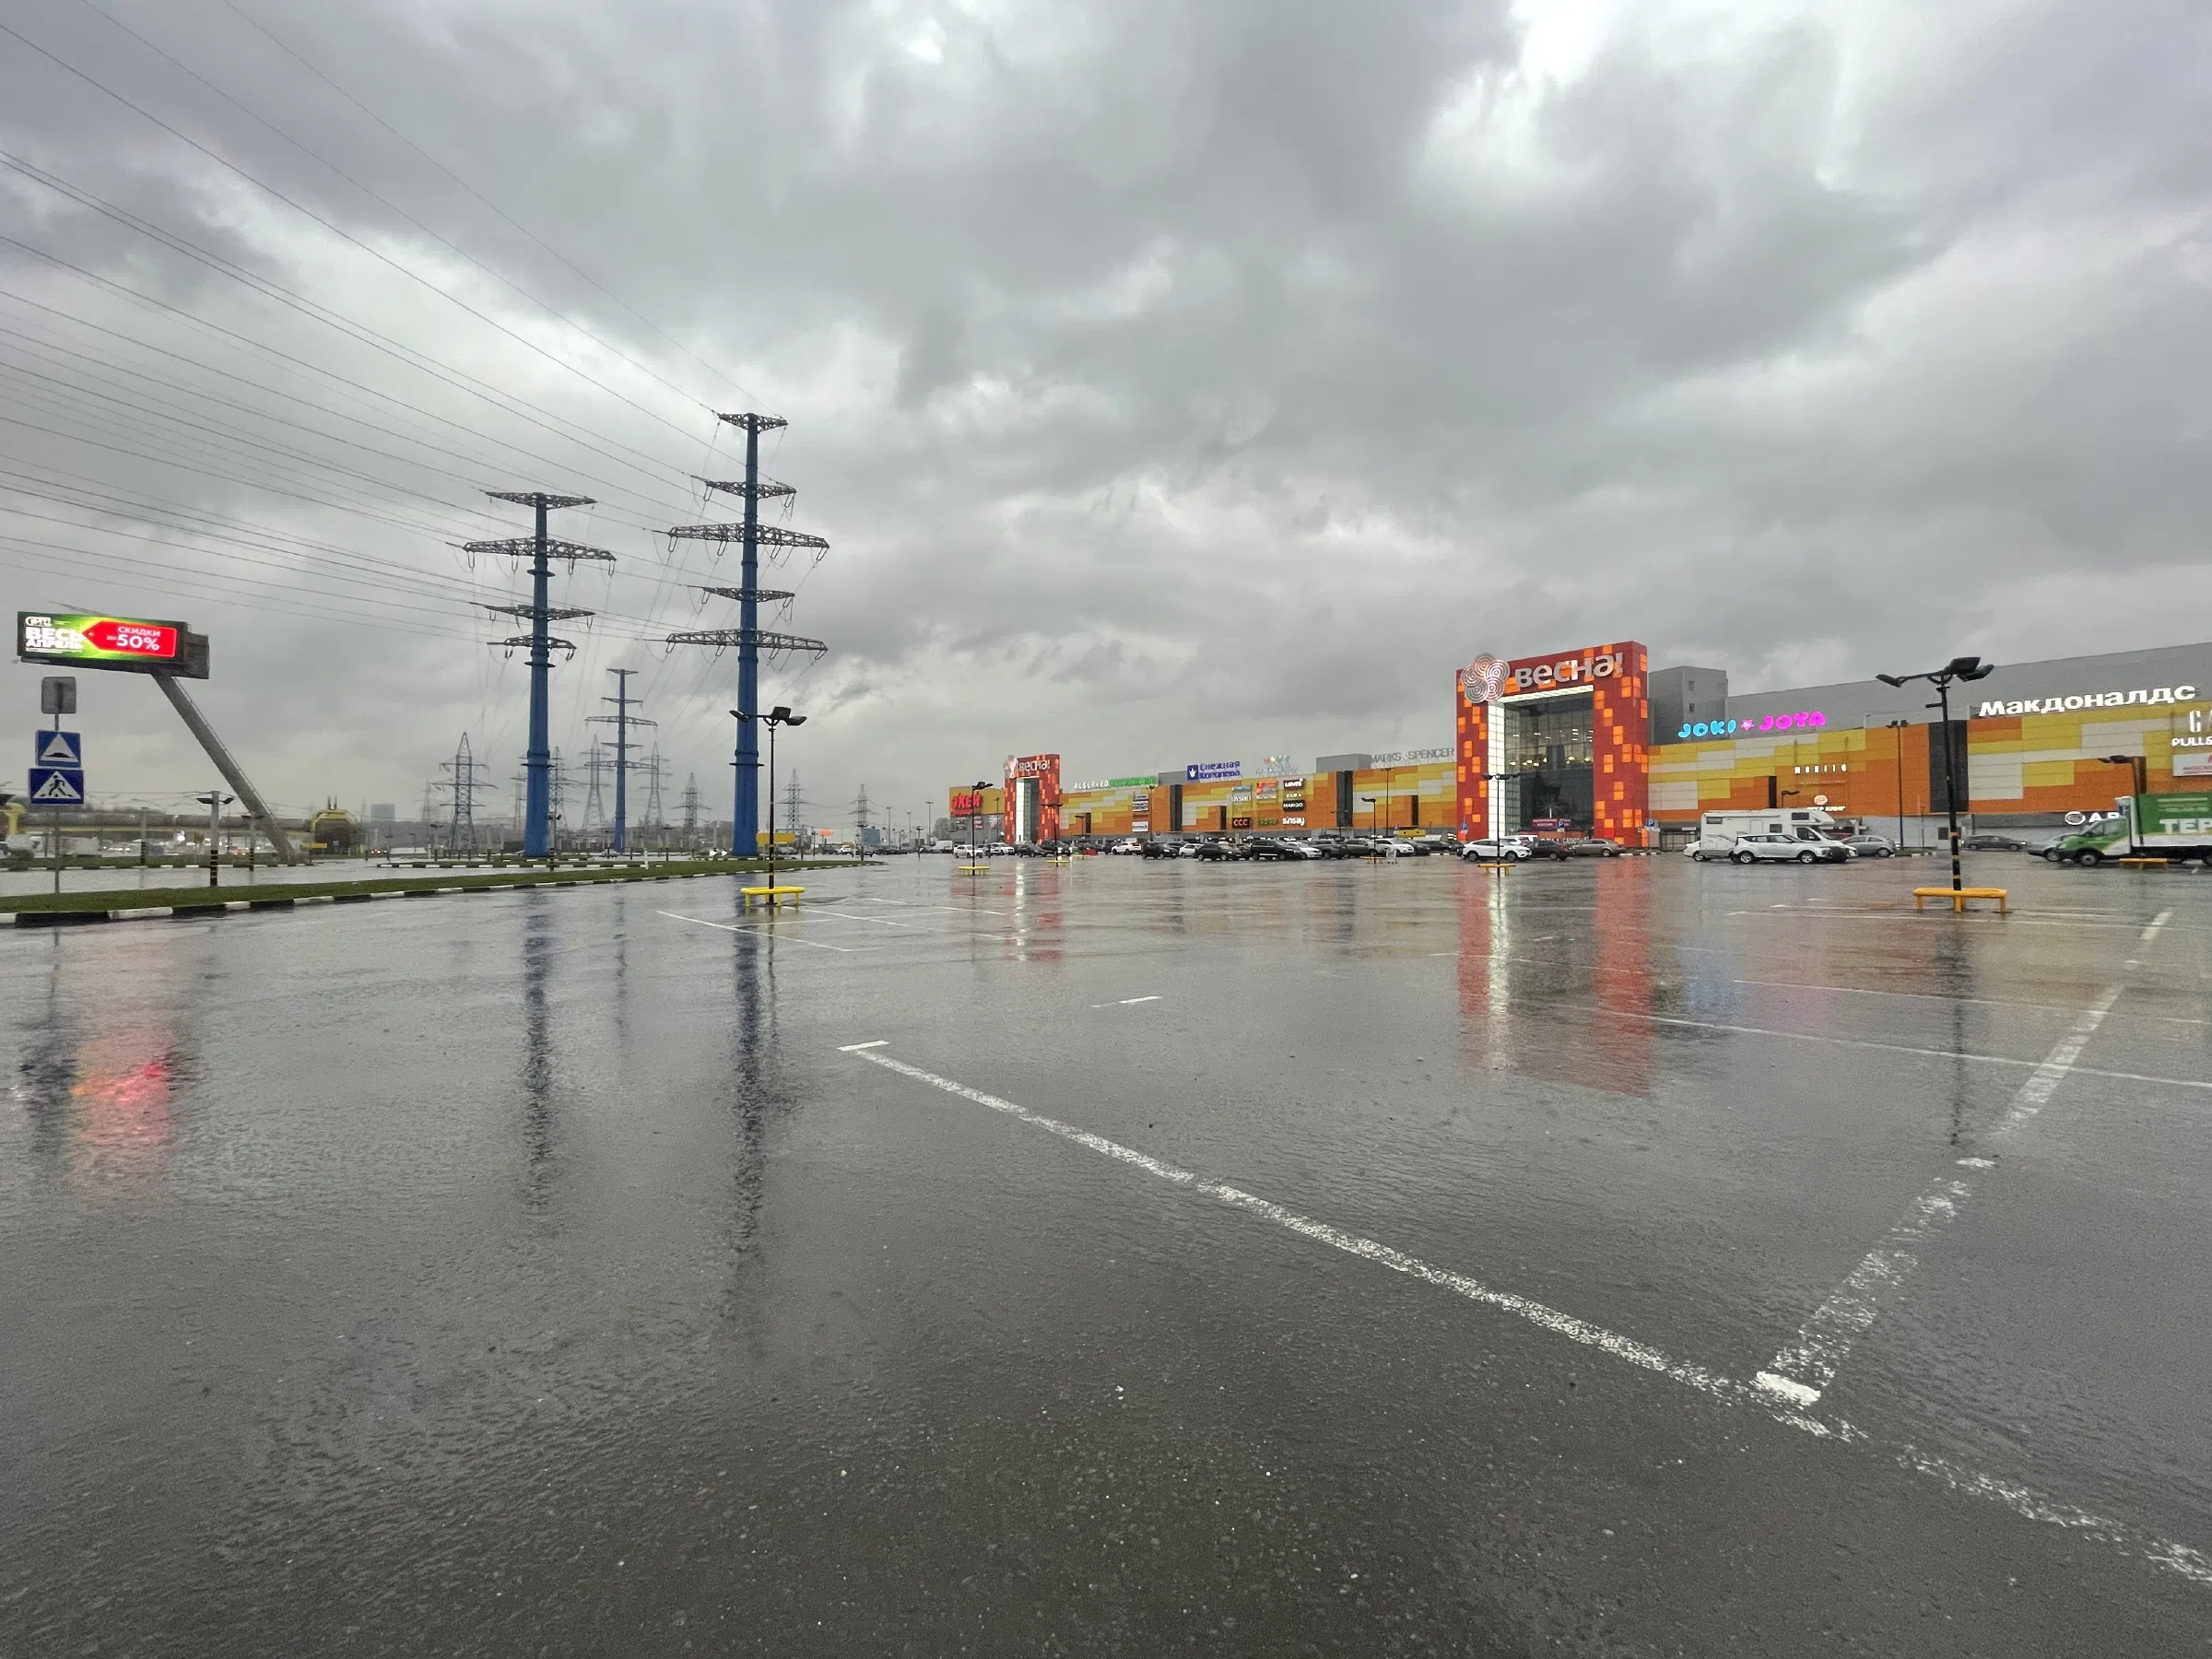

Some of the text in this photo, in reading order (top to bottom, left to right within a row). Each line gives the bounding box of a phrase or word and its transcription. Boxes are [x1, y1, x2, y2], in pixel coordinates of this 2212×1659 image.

[26, 627, 85, 642] ВЕСЬ
[118, 626, 161, 637] СКИДКИ
[1978, 685, 2195, 716] Макдоналдс
[1677, 711, 1826, 738] JOKI JOYA
[1371, 752, 1401, 763] MARKS
[1408, 747, 1454, 760] SPENCER
[1199, 760, 1241, 771] Снежная
[1074, 780, 1109, 790] RESERVED
[1233, 818, 1248, 827] CCC
[1282, 816, 1305, 827] sinsay
